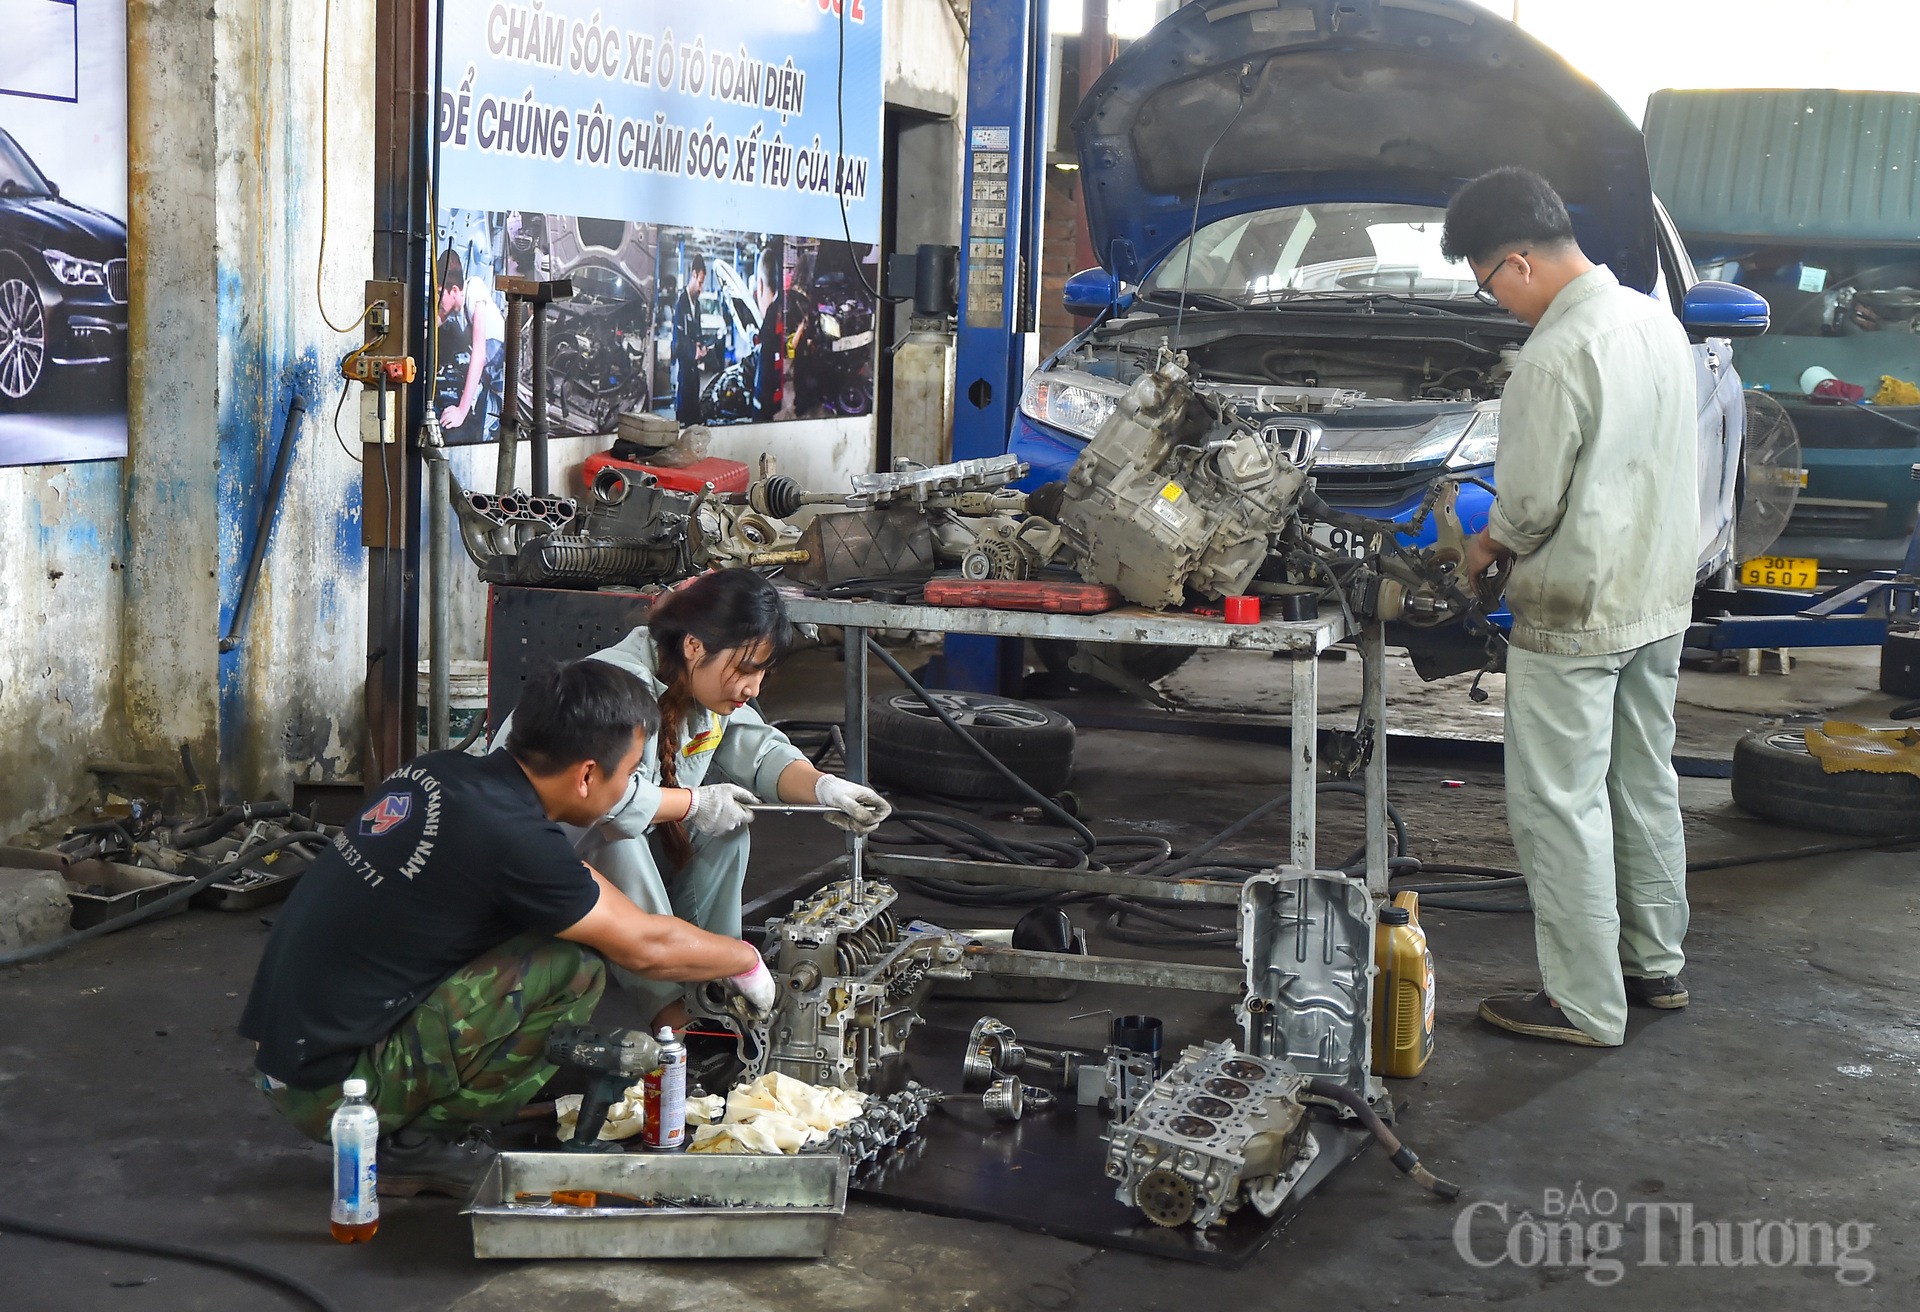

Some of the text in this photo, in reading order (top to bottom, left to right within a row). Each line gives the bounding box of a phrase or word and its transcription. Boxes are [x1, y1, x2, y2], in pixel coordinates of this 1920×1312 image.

[487, 0, 804, 123] CHĂM SÓC XE Ô TÔ TOÀN DIỆN
[477, 90, 569, 158] CHÚNG
[577, 103, 612, 164] TÔI
[618, 115, 683, 173] CHĂM
[687, 122, 728, 179] SÓC
[732, 124, 762, 182] XẾ
[762, 134, 792, 187] YÊU
[796, 137, 829, 193] CỦA
[1750, 570, 1808, 586] 9607
[1764, 557, 1796, 570] 30T
[423, 789, 442, 837] MẠNH
[341, 844, 362, 867] 353
[356, 861, 385, 888] 711
[399, 840, 434, 881] NAM
